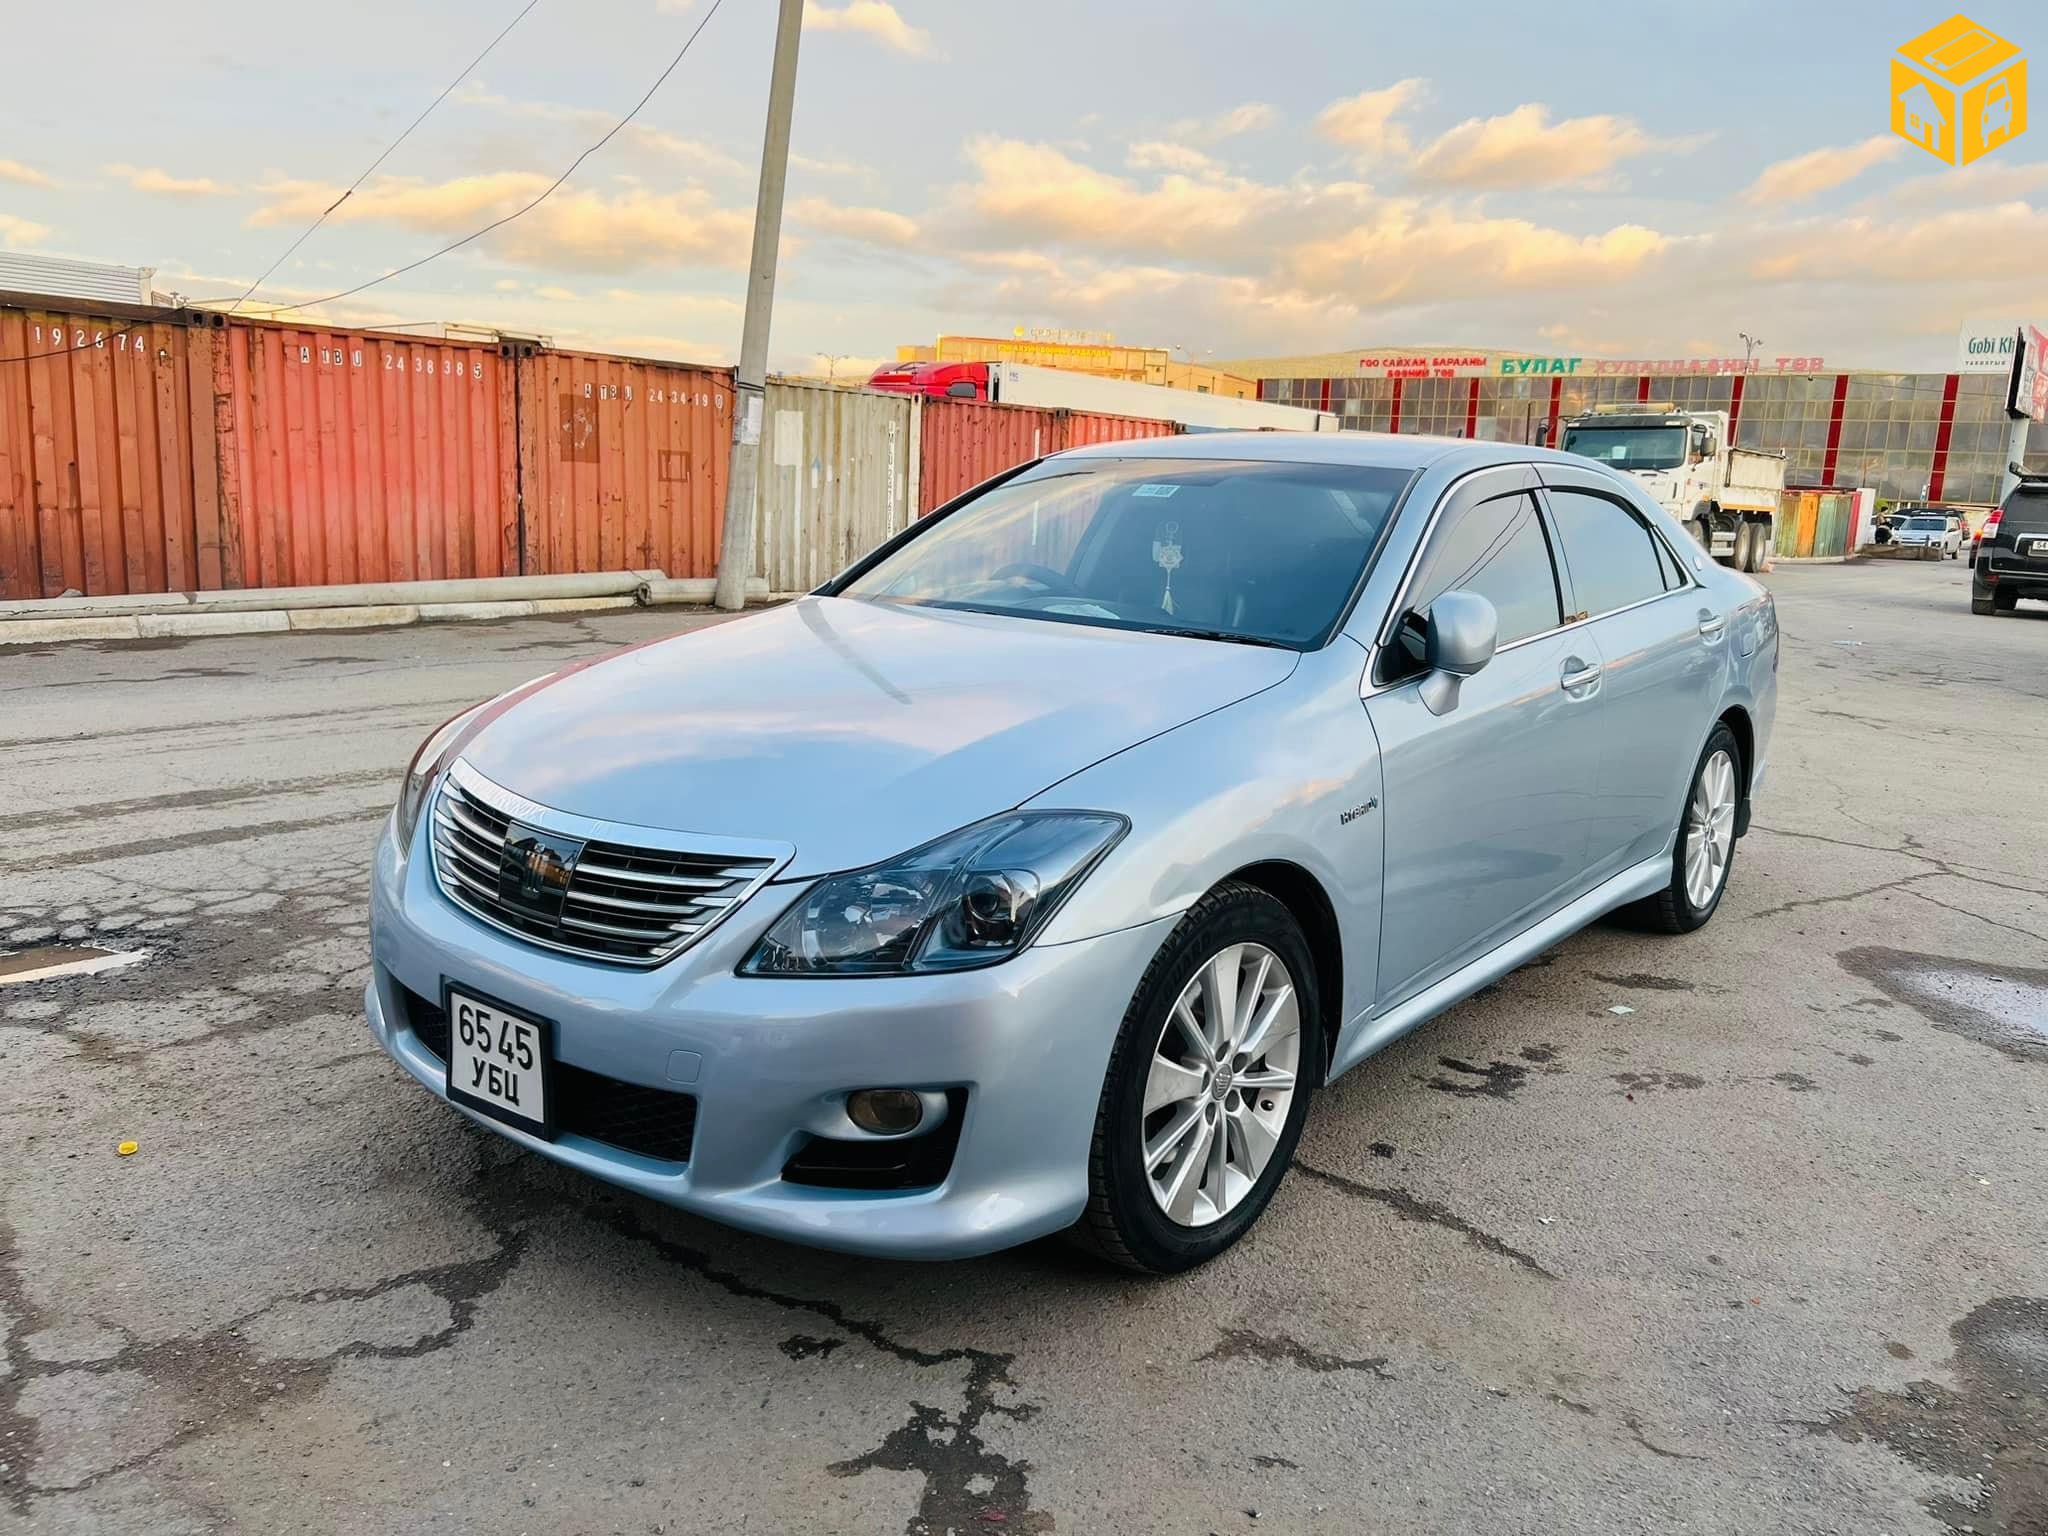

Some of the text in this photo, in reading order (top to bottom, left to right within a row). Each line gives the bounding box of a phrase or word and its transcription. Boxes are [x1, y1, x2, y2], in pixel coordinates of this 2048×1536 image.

[1968, 337, 2016, 354] Gobi Kh
[1360, 357, 1487, 368] ГОО САЙХАН БАРААНЫ
[1501, 358, 1582, 374] БУЛАГ
[472, 1056, 520, 1107] УБЦ
